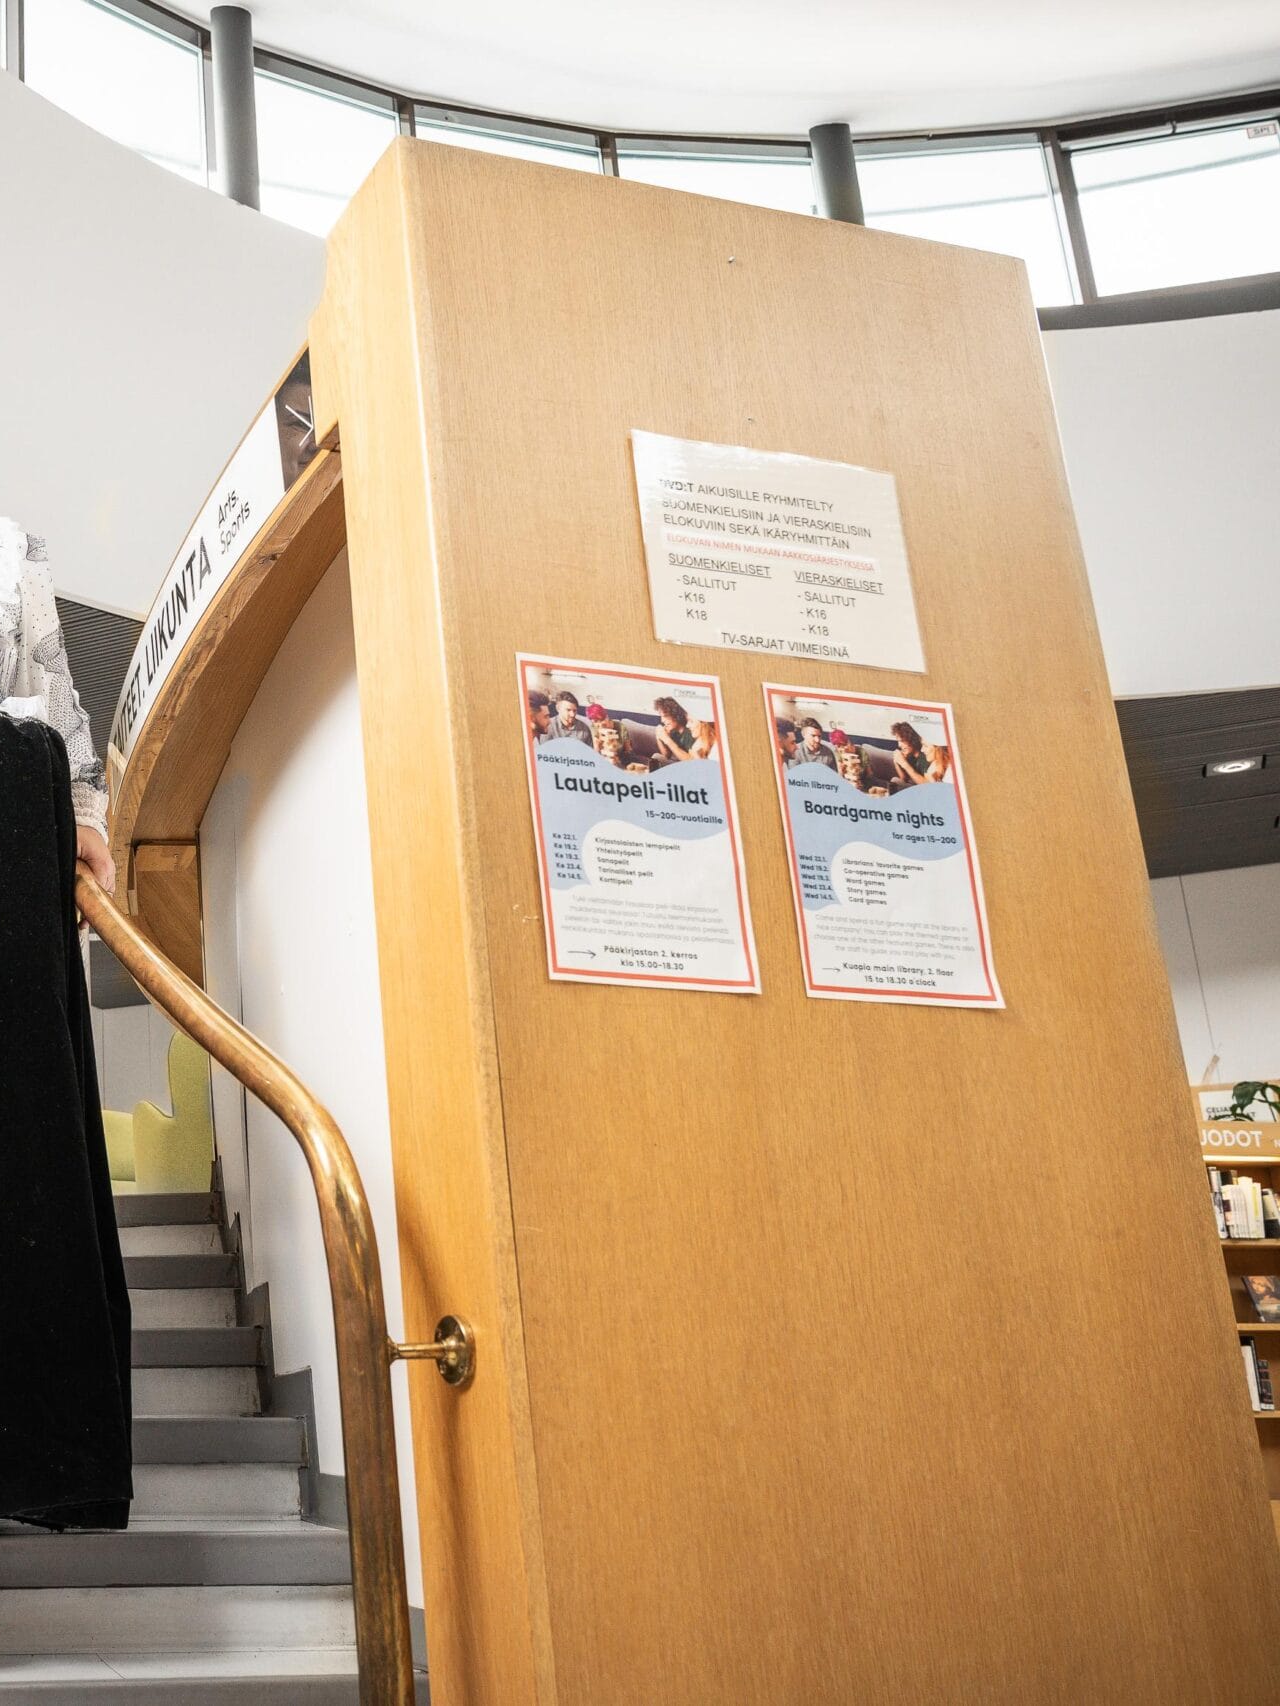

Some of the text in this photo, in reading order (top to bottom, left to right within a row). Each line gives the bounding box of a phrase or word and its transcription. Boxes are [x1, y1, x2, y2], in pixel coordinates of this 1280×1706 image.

[698, 484, 760, 502] AIKUISILLE
[763, 492, 833, 512] RYHMITELTY
[662, 499, 871, 538] SUOMENKIELISIIN JA VIERASKIELISIIN
[220, 501, 250, 555] Sports
[663, 513, 850, 549] ELOKUVIIN SEKÄ IKÄRYHMITTÄIN
[668, 552, 771, 577] SUOMENKIELISET
[793, 570, 883, 593] VIERASKIELISET
[804, 591, 856, 608] SALLITUT
[146, 536, 212, 685] LIIKUNTA
[686, 609, 708, 621] K18
[721, 632, 850, 658] TV-SARJAT VIIMEISINÄ
[537, 753, 596, 768] Pääkirjaston
[553, 772, 709, 805] Lautapeli-illat
[788, 778, 839, 793] Main library
[803, 800, 945, 829] Boardgame nights
[892, 832, 903, 840] for
[906, 834, 926, 843] ages
[887, 872, 909, 880] games
[902, 864, 924, 872] games
[865, 898, 887, 906] games
[604, 945, 659, 957] Pääkirjaston
[621, 959, 634, 967] klo
[843, 962, 871, 972] Kuopio
[936, 968, 954, 977] floor
